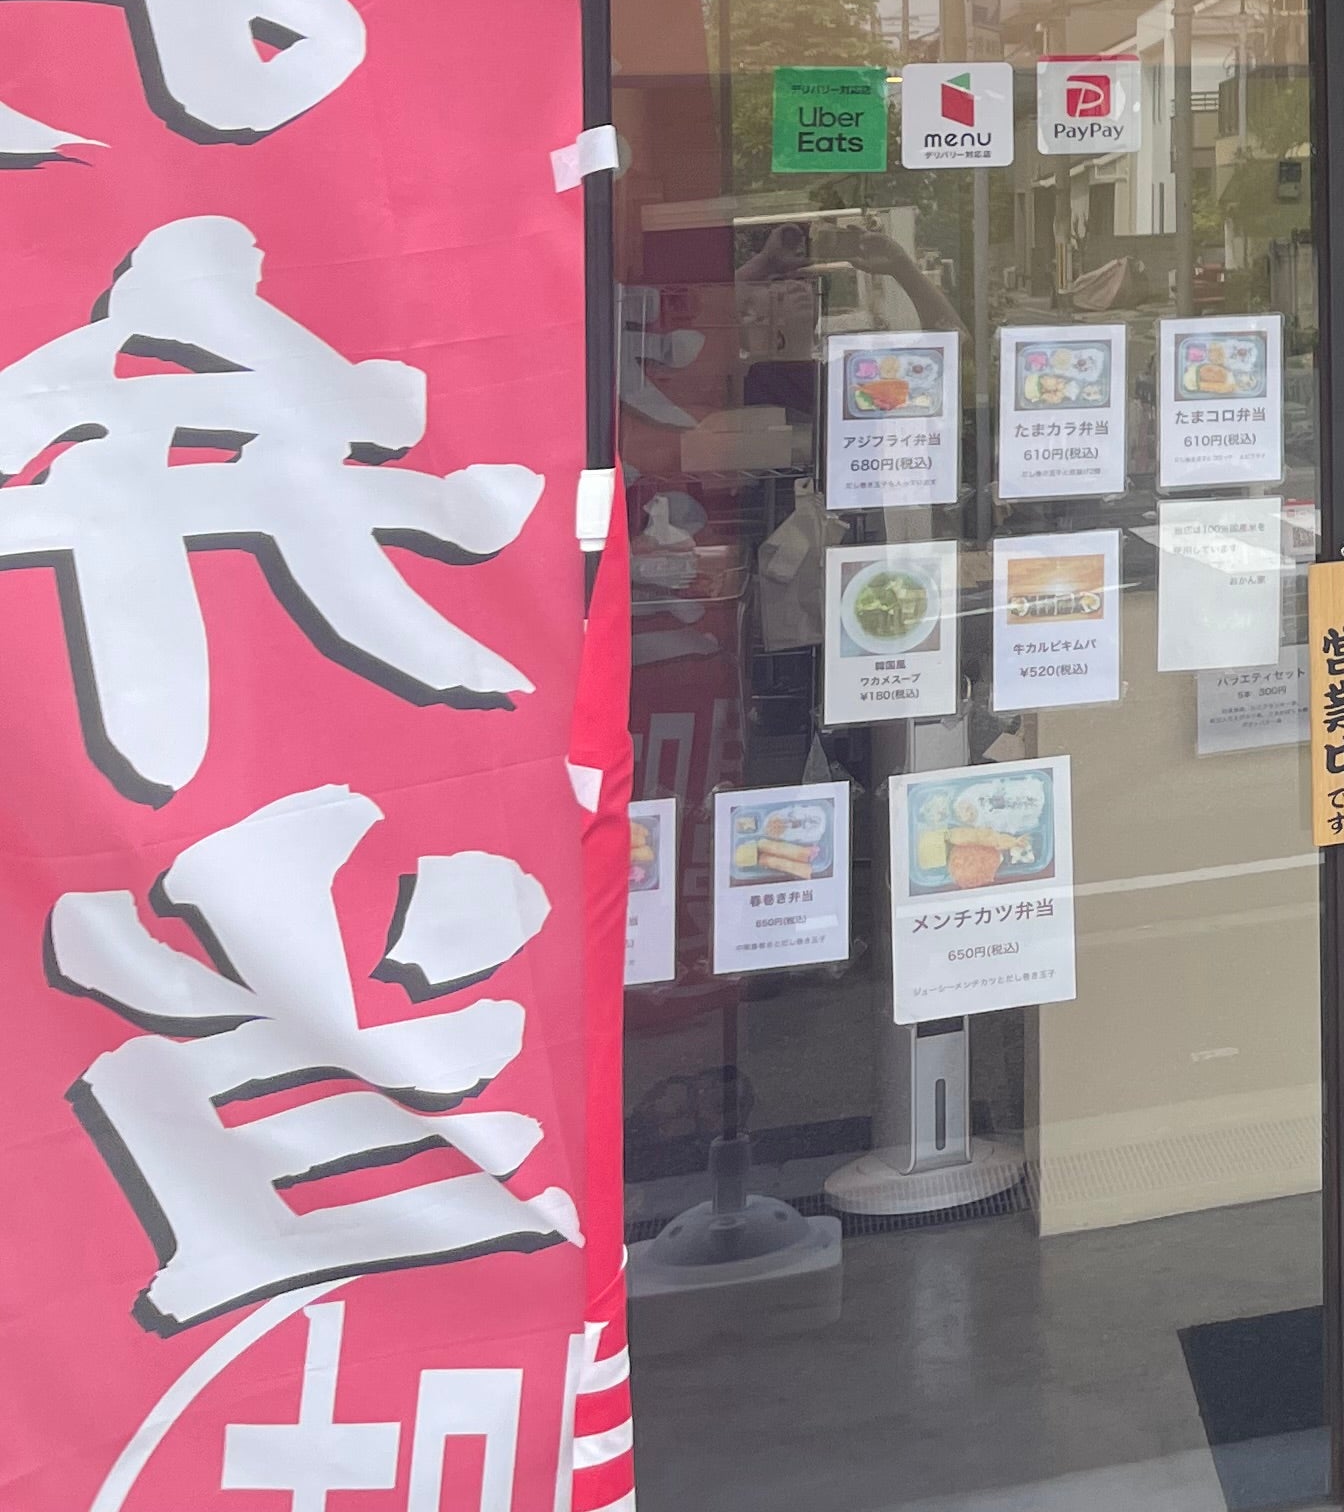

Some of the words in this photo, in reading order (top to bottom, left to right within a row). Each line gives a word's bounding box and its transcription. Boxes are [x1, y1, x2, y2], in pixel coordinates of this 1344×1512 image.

[799, 106, 864, 128] Uber
[924, 132, 991, 147] menu
[1054, 122, 1125, 141] PayPay
[798, 131, 863, 153] Eats
[1175, 406, 1265, 424] たまコロ弁当
[1015, 420, 1109, 438] たまカラ弁当
[843, 432, 941, 449] アジフライ弁当
[1184, 433, 1256, 447] 610円(税込)
[1024, 447, 1099, 461] 610円(税込)
[850, 456, 932, 471] 680円(税込)
[860, 673, 920, 686] ワカメスープ
[912, 898, 1054, 933] メンチカツ弁当
[948, 942, 1019, 961] 650円(税込)
